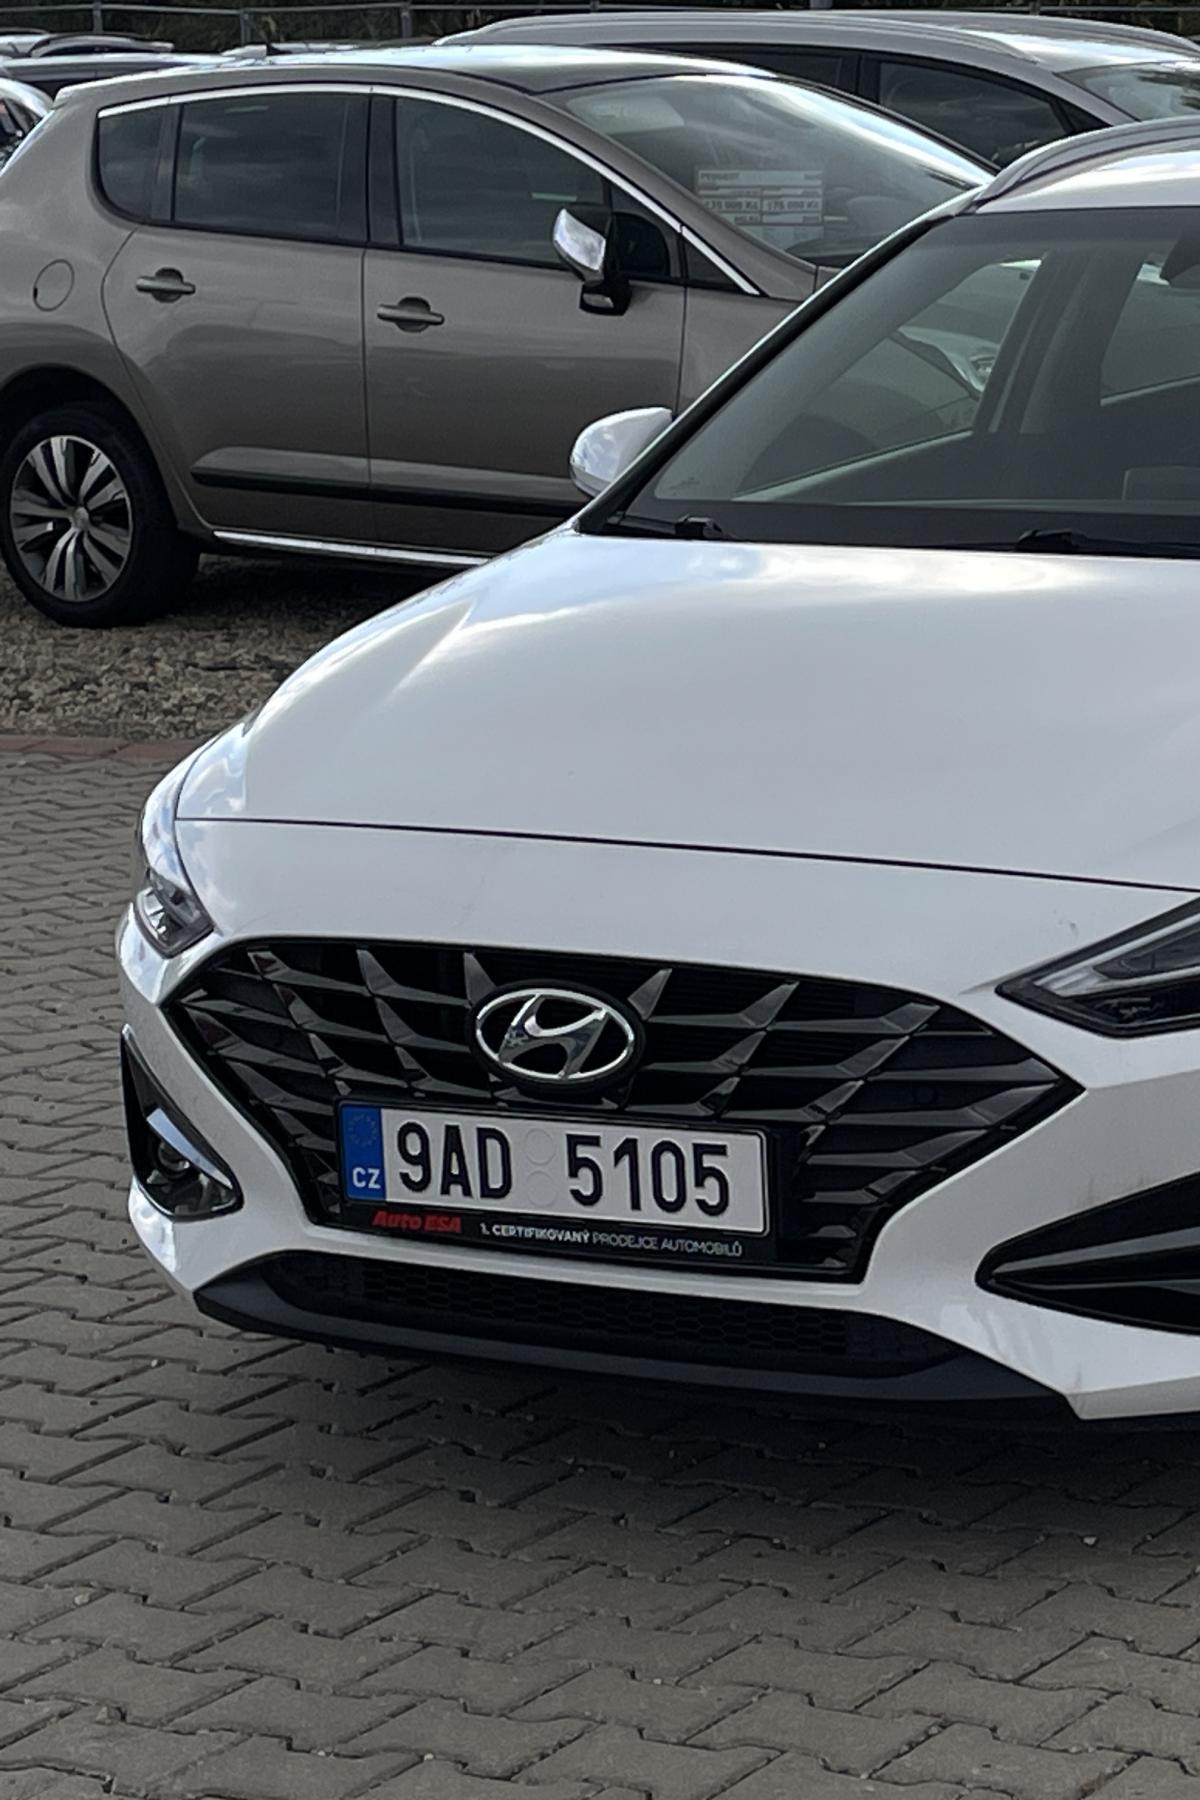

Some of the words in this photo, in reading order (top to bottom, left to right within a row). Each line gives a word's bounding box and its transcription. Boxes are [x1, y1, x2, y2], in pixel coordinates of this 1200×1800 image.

[352, 1167, 381, 1190] CZ
[397, 1121, 512, 1200] 9AD
[566, 1133, 730, 1217] 5105
[372, 1210, 422, 1231] Auto
[424, 1214, 462, 1233] ESA
[492, 1225, 591, 1244] CERTIFIKOVANÝ
[592, 1232, 659, 1250] PRODEJCE
[660, 1237, 743, 1257] AUTOMOBILŮ
